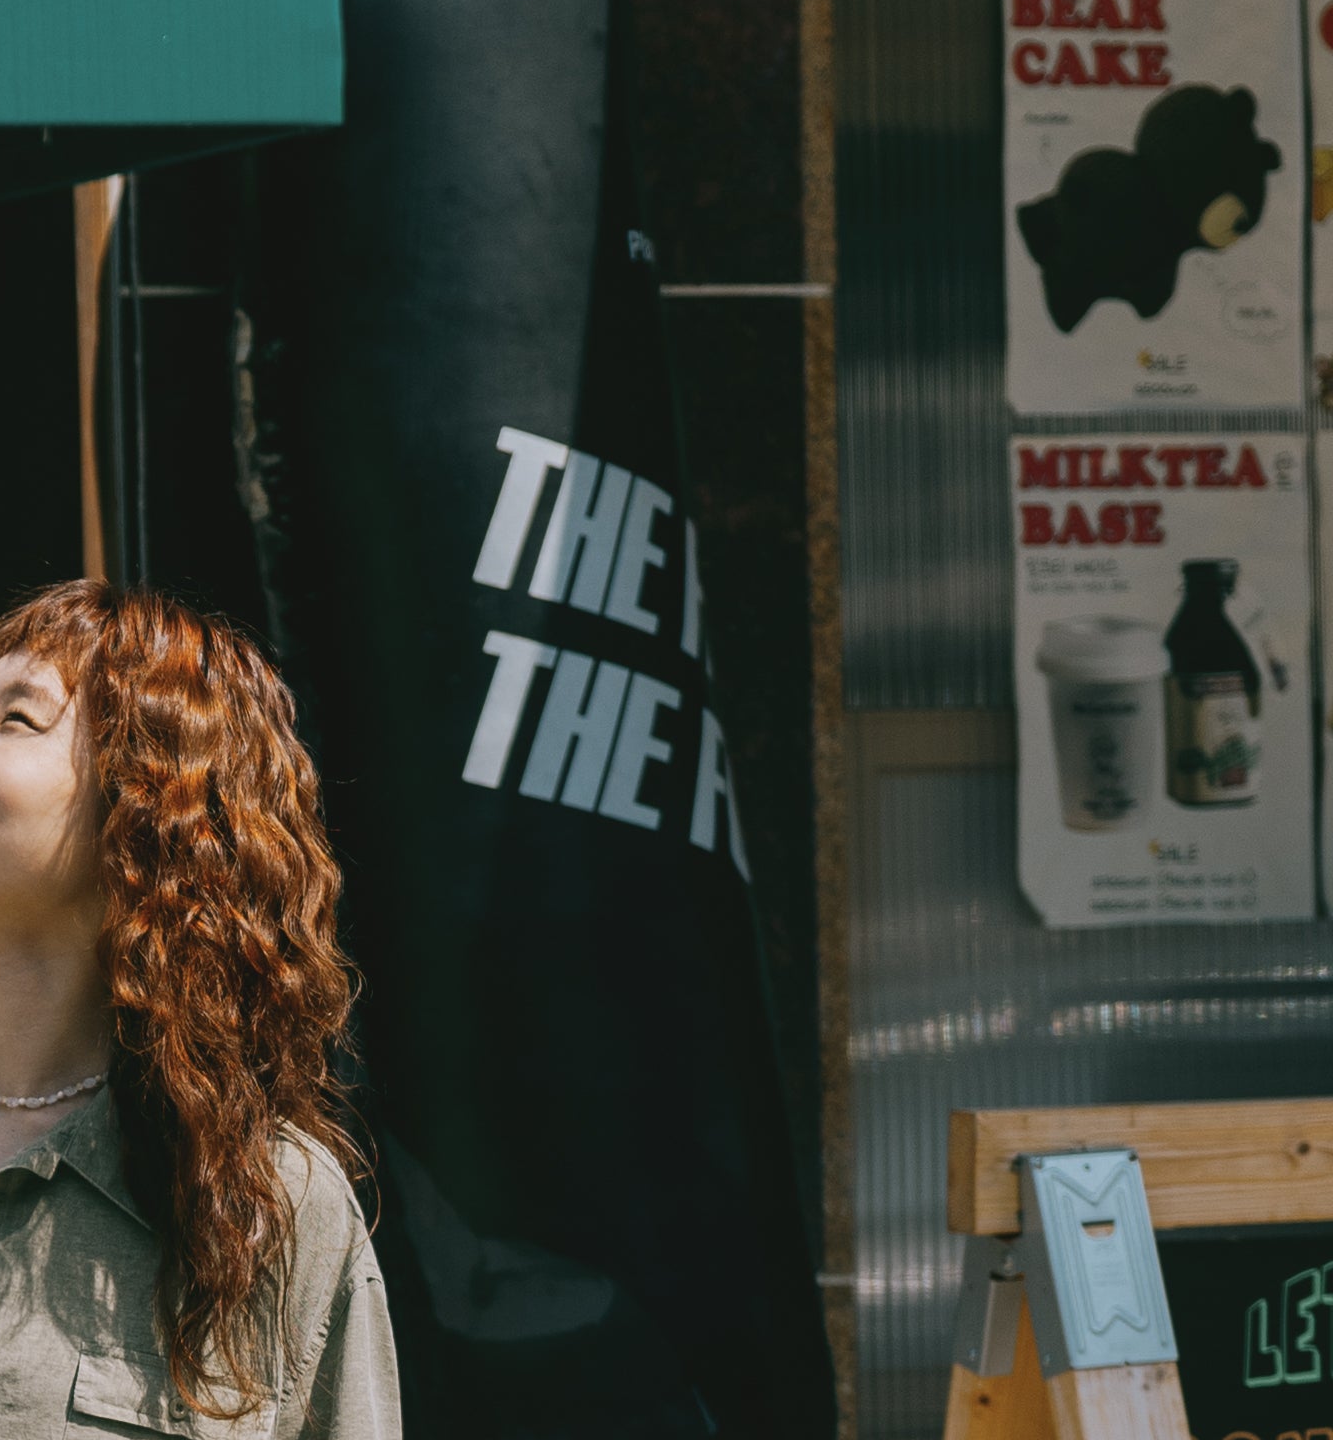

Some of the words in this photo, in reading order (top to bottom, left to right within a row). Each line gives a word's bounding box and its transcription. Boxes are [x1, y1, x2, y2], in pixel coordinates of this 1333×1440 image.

[1011, 40, 1172, 87] CAKE
[1018, 443, 1267, 490] MILKTEA
[473, 426, 673, 635] THE
[1021, 503, 1165, 546] BASE
[461, 629, 681, 831] THE
